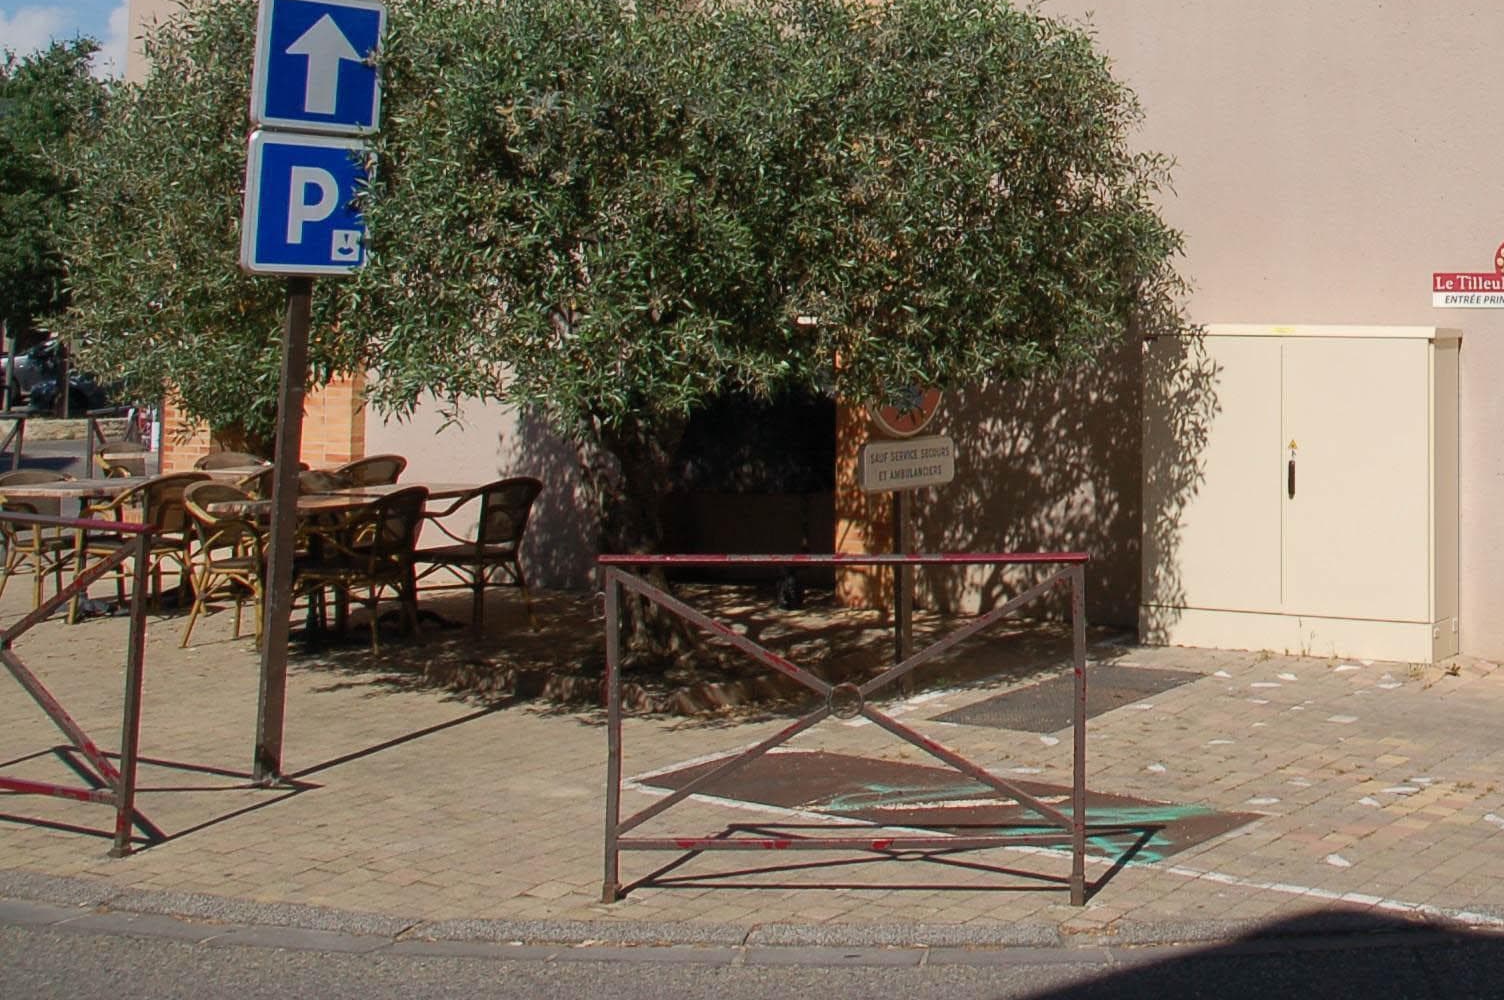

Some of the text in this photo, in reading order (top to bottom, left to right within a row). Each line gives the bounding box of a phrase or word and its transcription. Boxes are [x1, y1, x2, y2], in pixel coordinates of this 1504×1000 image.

[285, 165, 339, 245] P
[1435, 276, 1454, 291] Le
[1445, 294, 1482, 305] ENTRÉE
[870, 446, 950, 465] SAUF SERVICE SECOURS
[879, 471, 887, 481] ET
